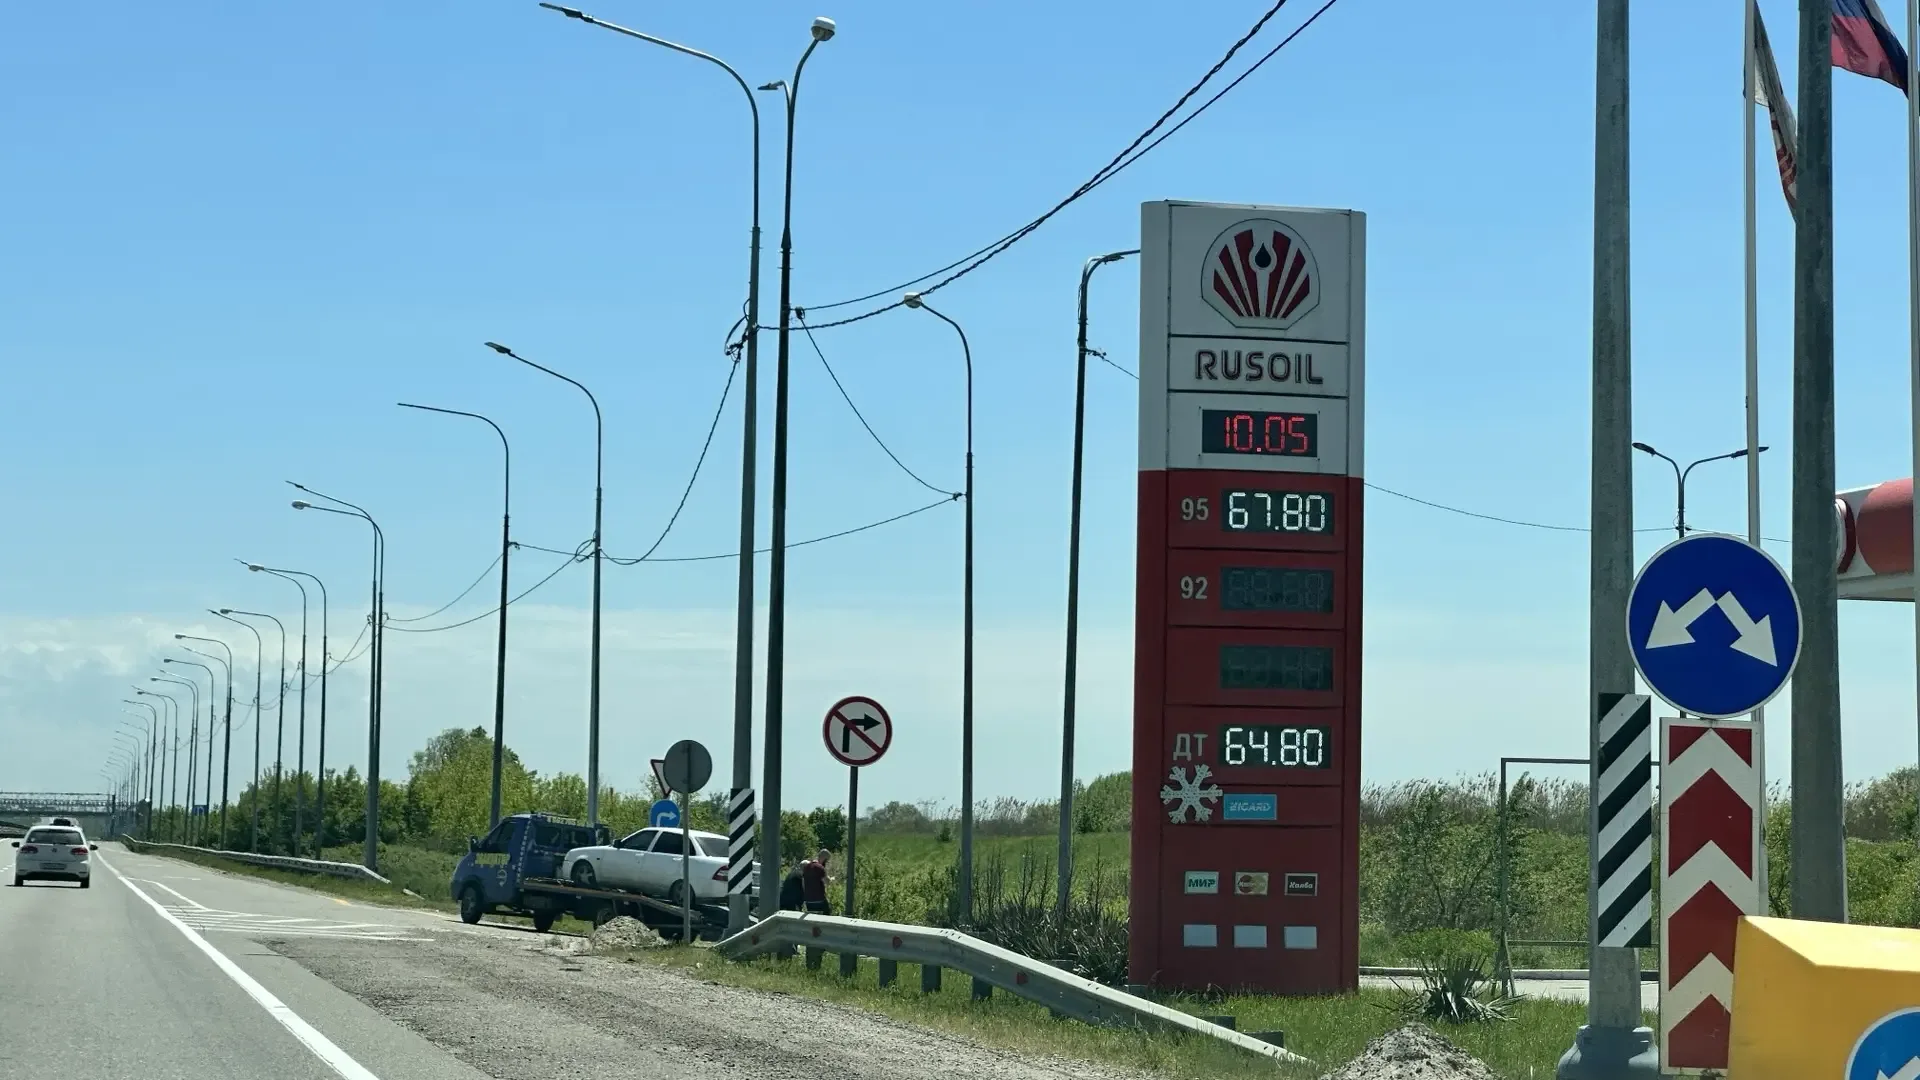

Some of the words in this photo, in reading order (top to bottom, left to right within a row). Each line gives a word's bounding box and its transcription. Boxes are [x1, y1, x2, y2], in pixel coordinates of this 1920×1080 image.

[1195, 350, 1324, 385] RUSOIL
[1224, 414, 1309, 453] 10.05
[1181, 498, 1209, 521] 95
[1228, 492, 1326, 531] 67.80
[1180, 576, 1208, 600] 92
[1172, 733, 1208, 761] ДТ
[1225, 728, 1323, 766] 64.80
[1188, 878, 1216, 888] МИР
